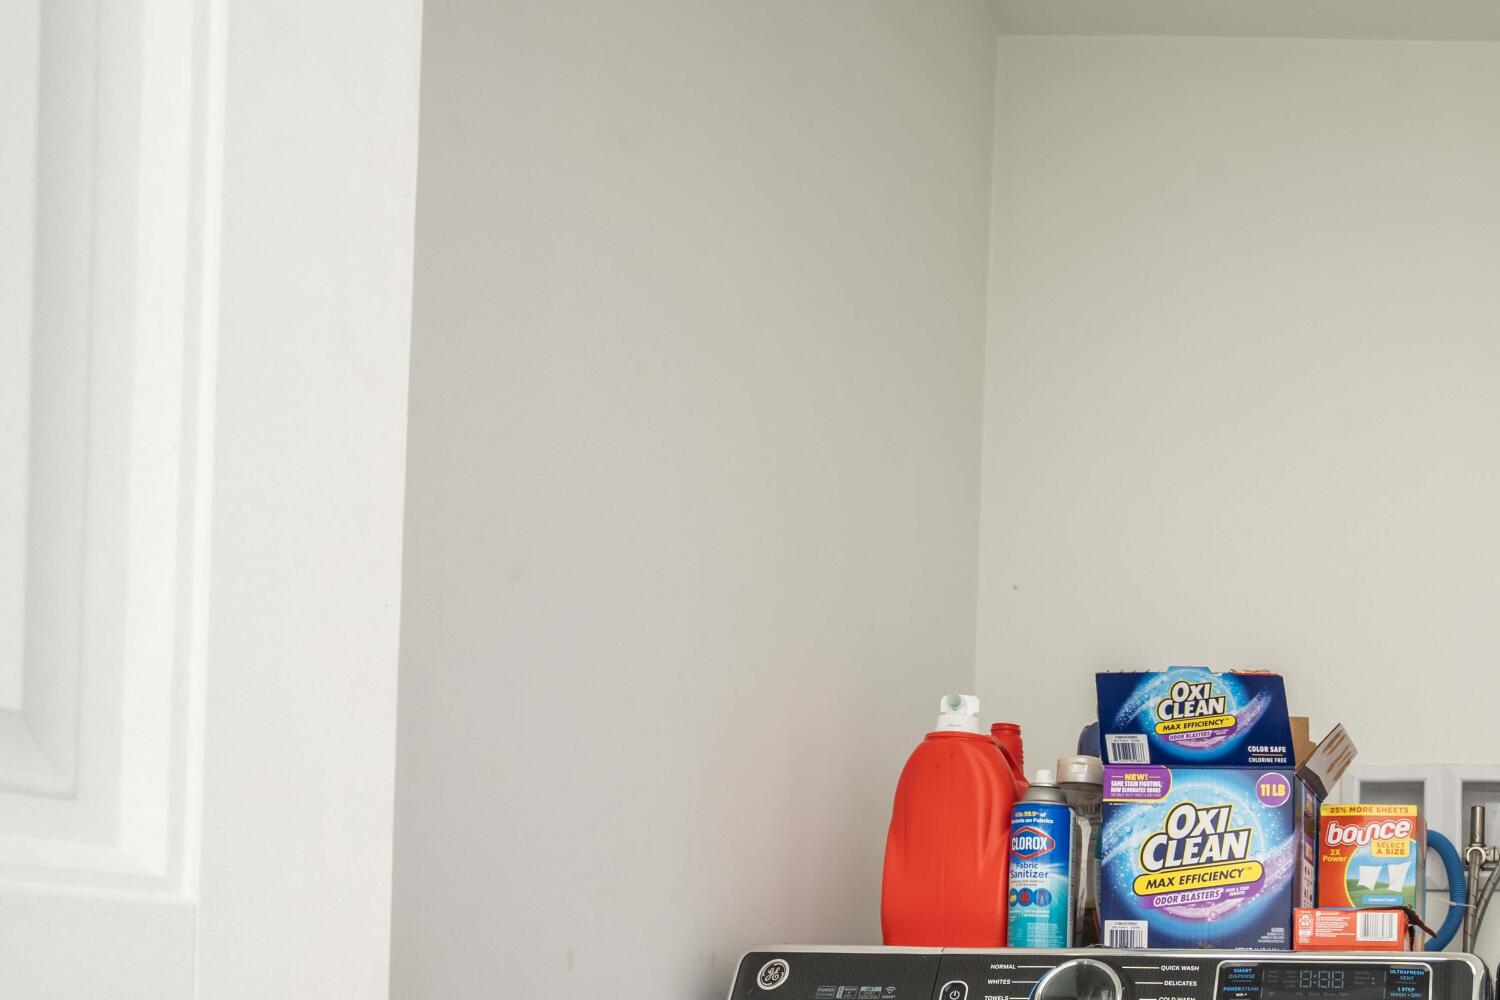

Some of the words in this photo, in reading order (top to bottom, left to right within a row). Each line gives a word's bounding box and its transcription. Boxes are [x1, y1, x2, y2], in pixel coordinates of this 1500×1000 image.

[1171, 681, 1212, 702] OXI
[1158, 696, 1226, 721] CLEAN
[1162, 722, 1181, 732] MAX
[1182, 718, 1225, 729] EFFICIENCY
[1124, 773, 1149, 781] NEW!
[1260, 784, 1271, 796] 11
[1271, 784, 1286, 797] LB
[1166, 802, 1233, 839] OXI
[1326, 820, 1411, 846] bounce
[1012, 837, 1048, 850] CLOROX
[1141, 828, 1252, 872] CLEAN
[1010, 870, 1049, 879] Sanitizer
[1145, 877, 1176, 890] MAX
[1178, 868, 1245, 885] EFFICIENCY
[1155, 895, 1179, 906] ODOR
[1180, 889, 1220, 902] BLASTERS
